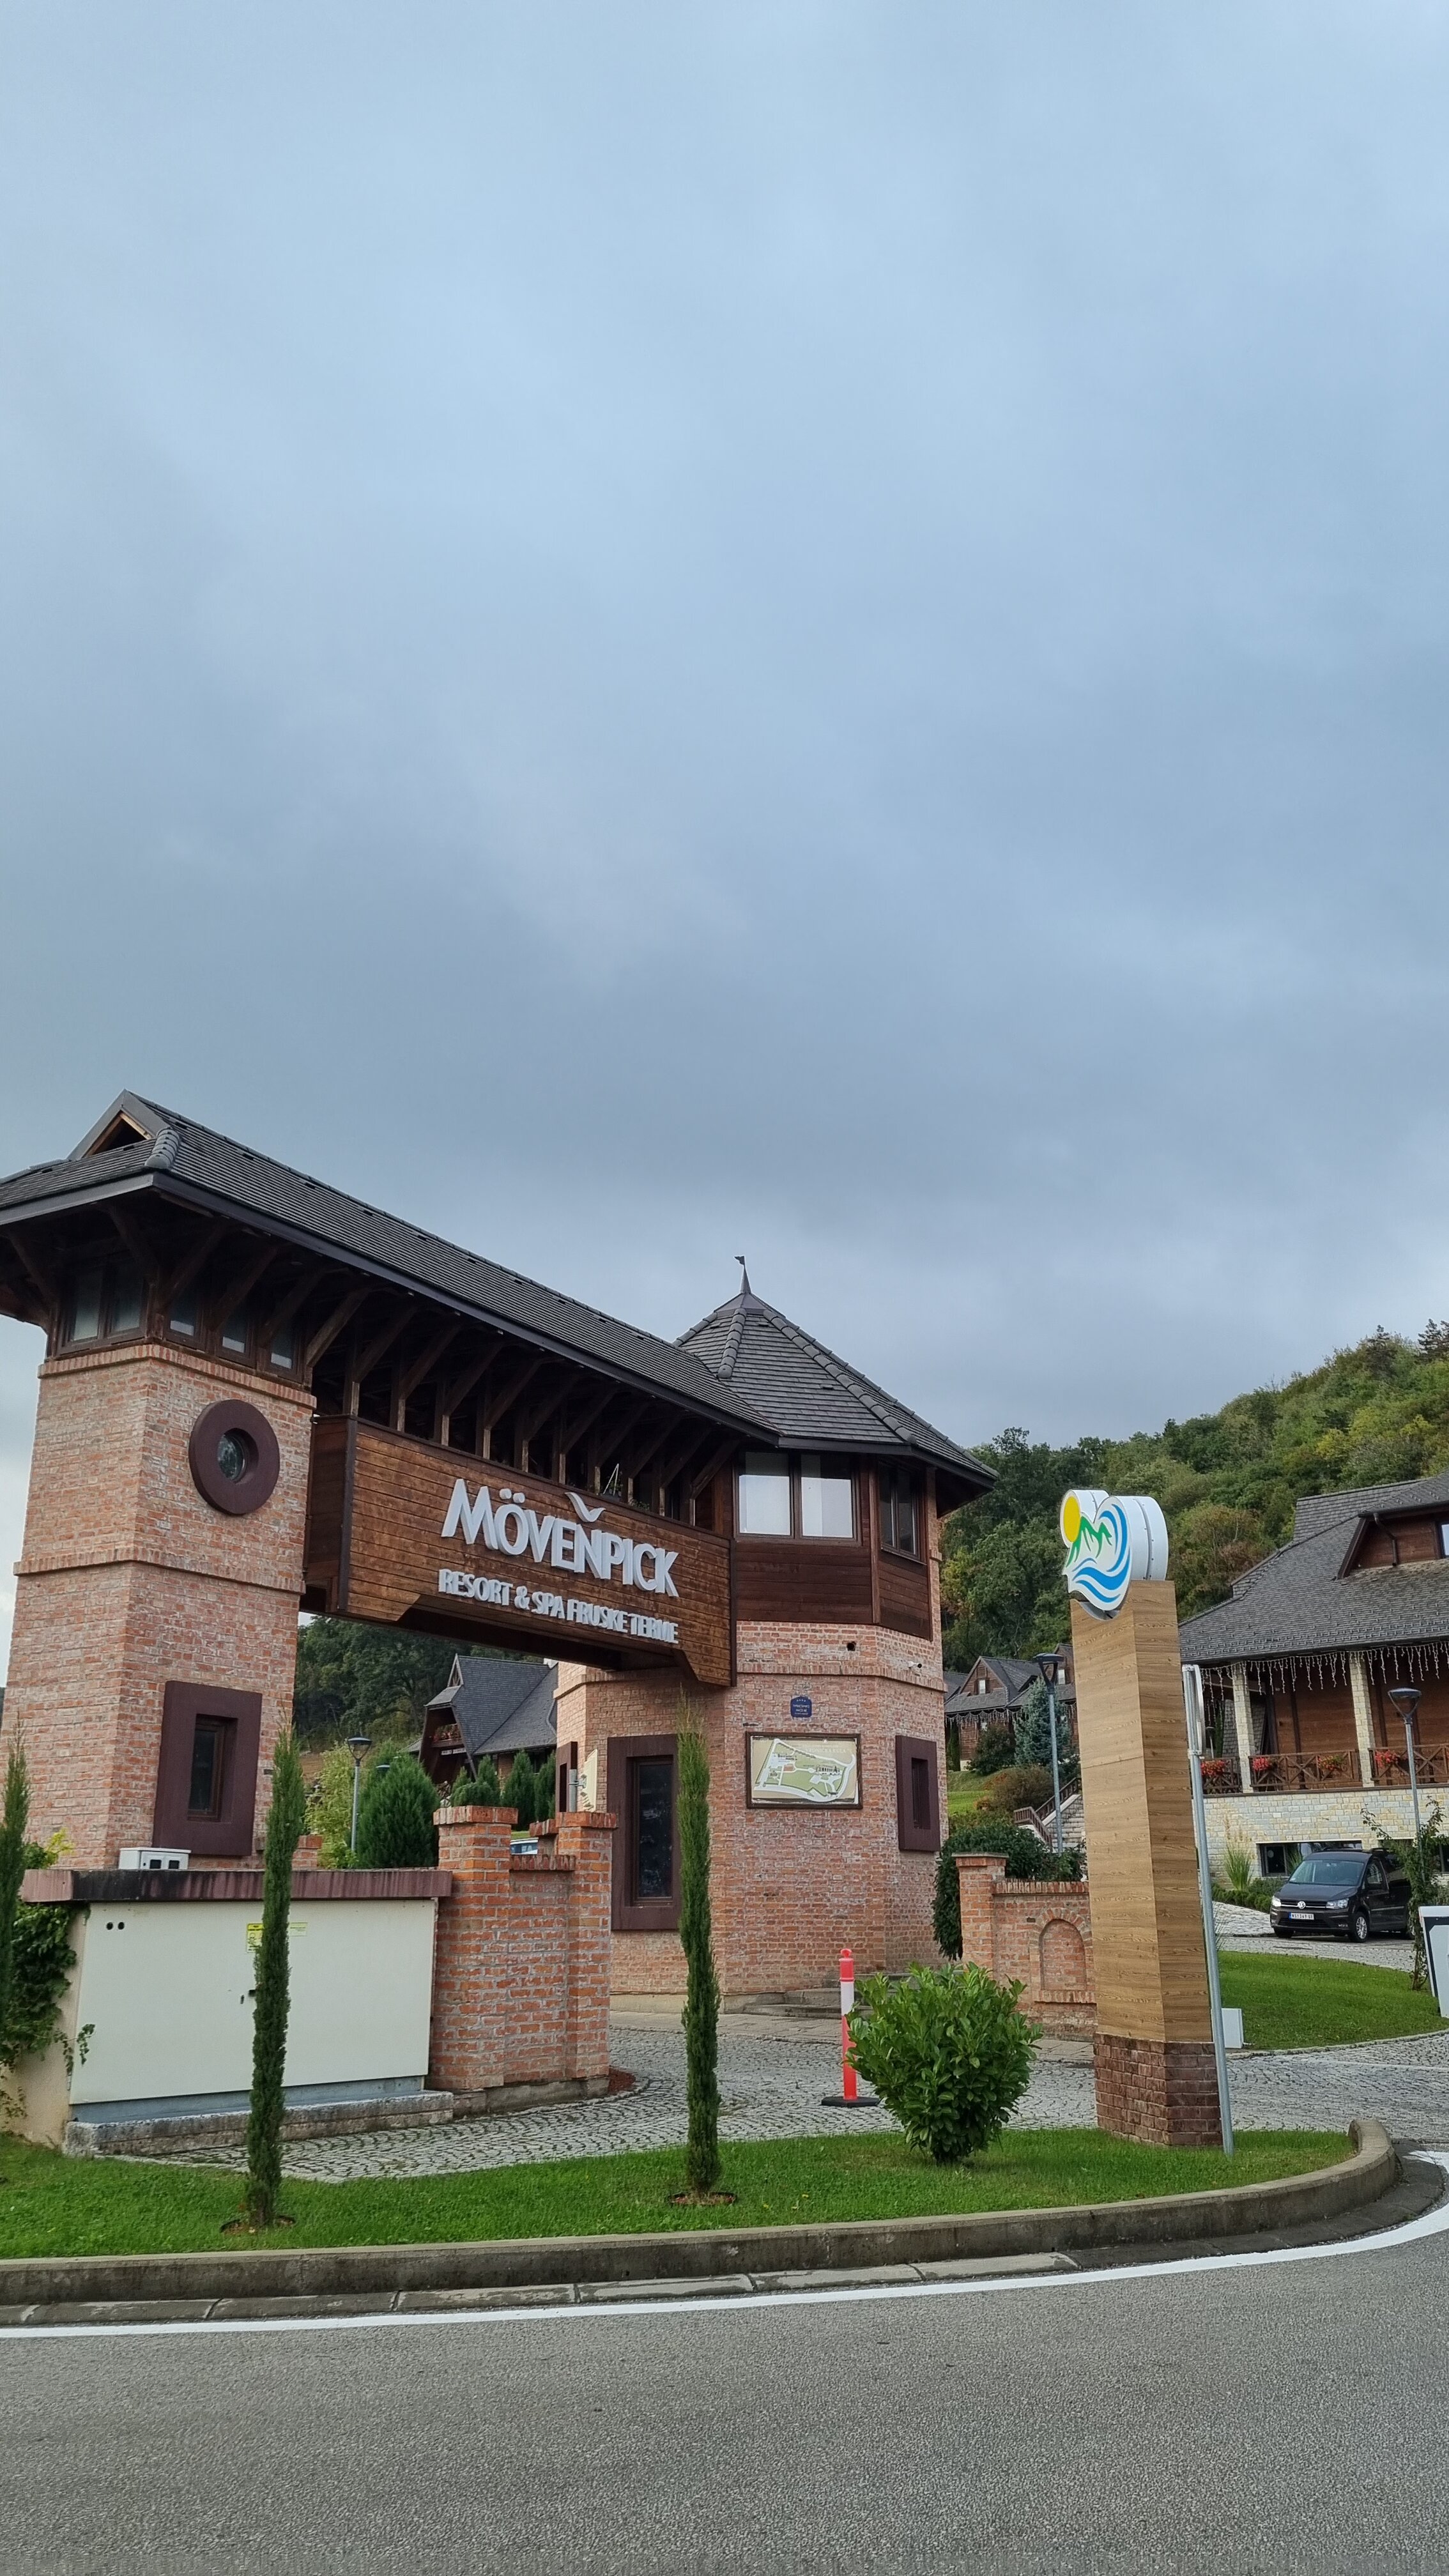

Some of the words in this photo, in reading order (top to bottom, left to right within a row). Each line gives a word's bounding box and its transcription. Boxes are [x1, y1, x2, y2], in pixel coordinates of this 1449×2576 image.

[441, 1478, 679, 1597] MÖVENPICK
[438, 1568, 513, 1606] RESORT
[514, 1585, 530, 1611] &
[531, 1591, 565, 1619] SPA
[567, 1598, 629, 1634] FRUSKE
[627, 1613, 679, 1644] TERME
